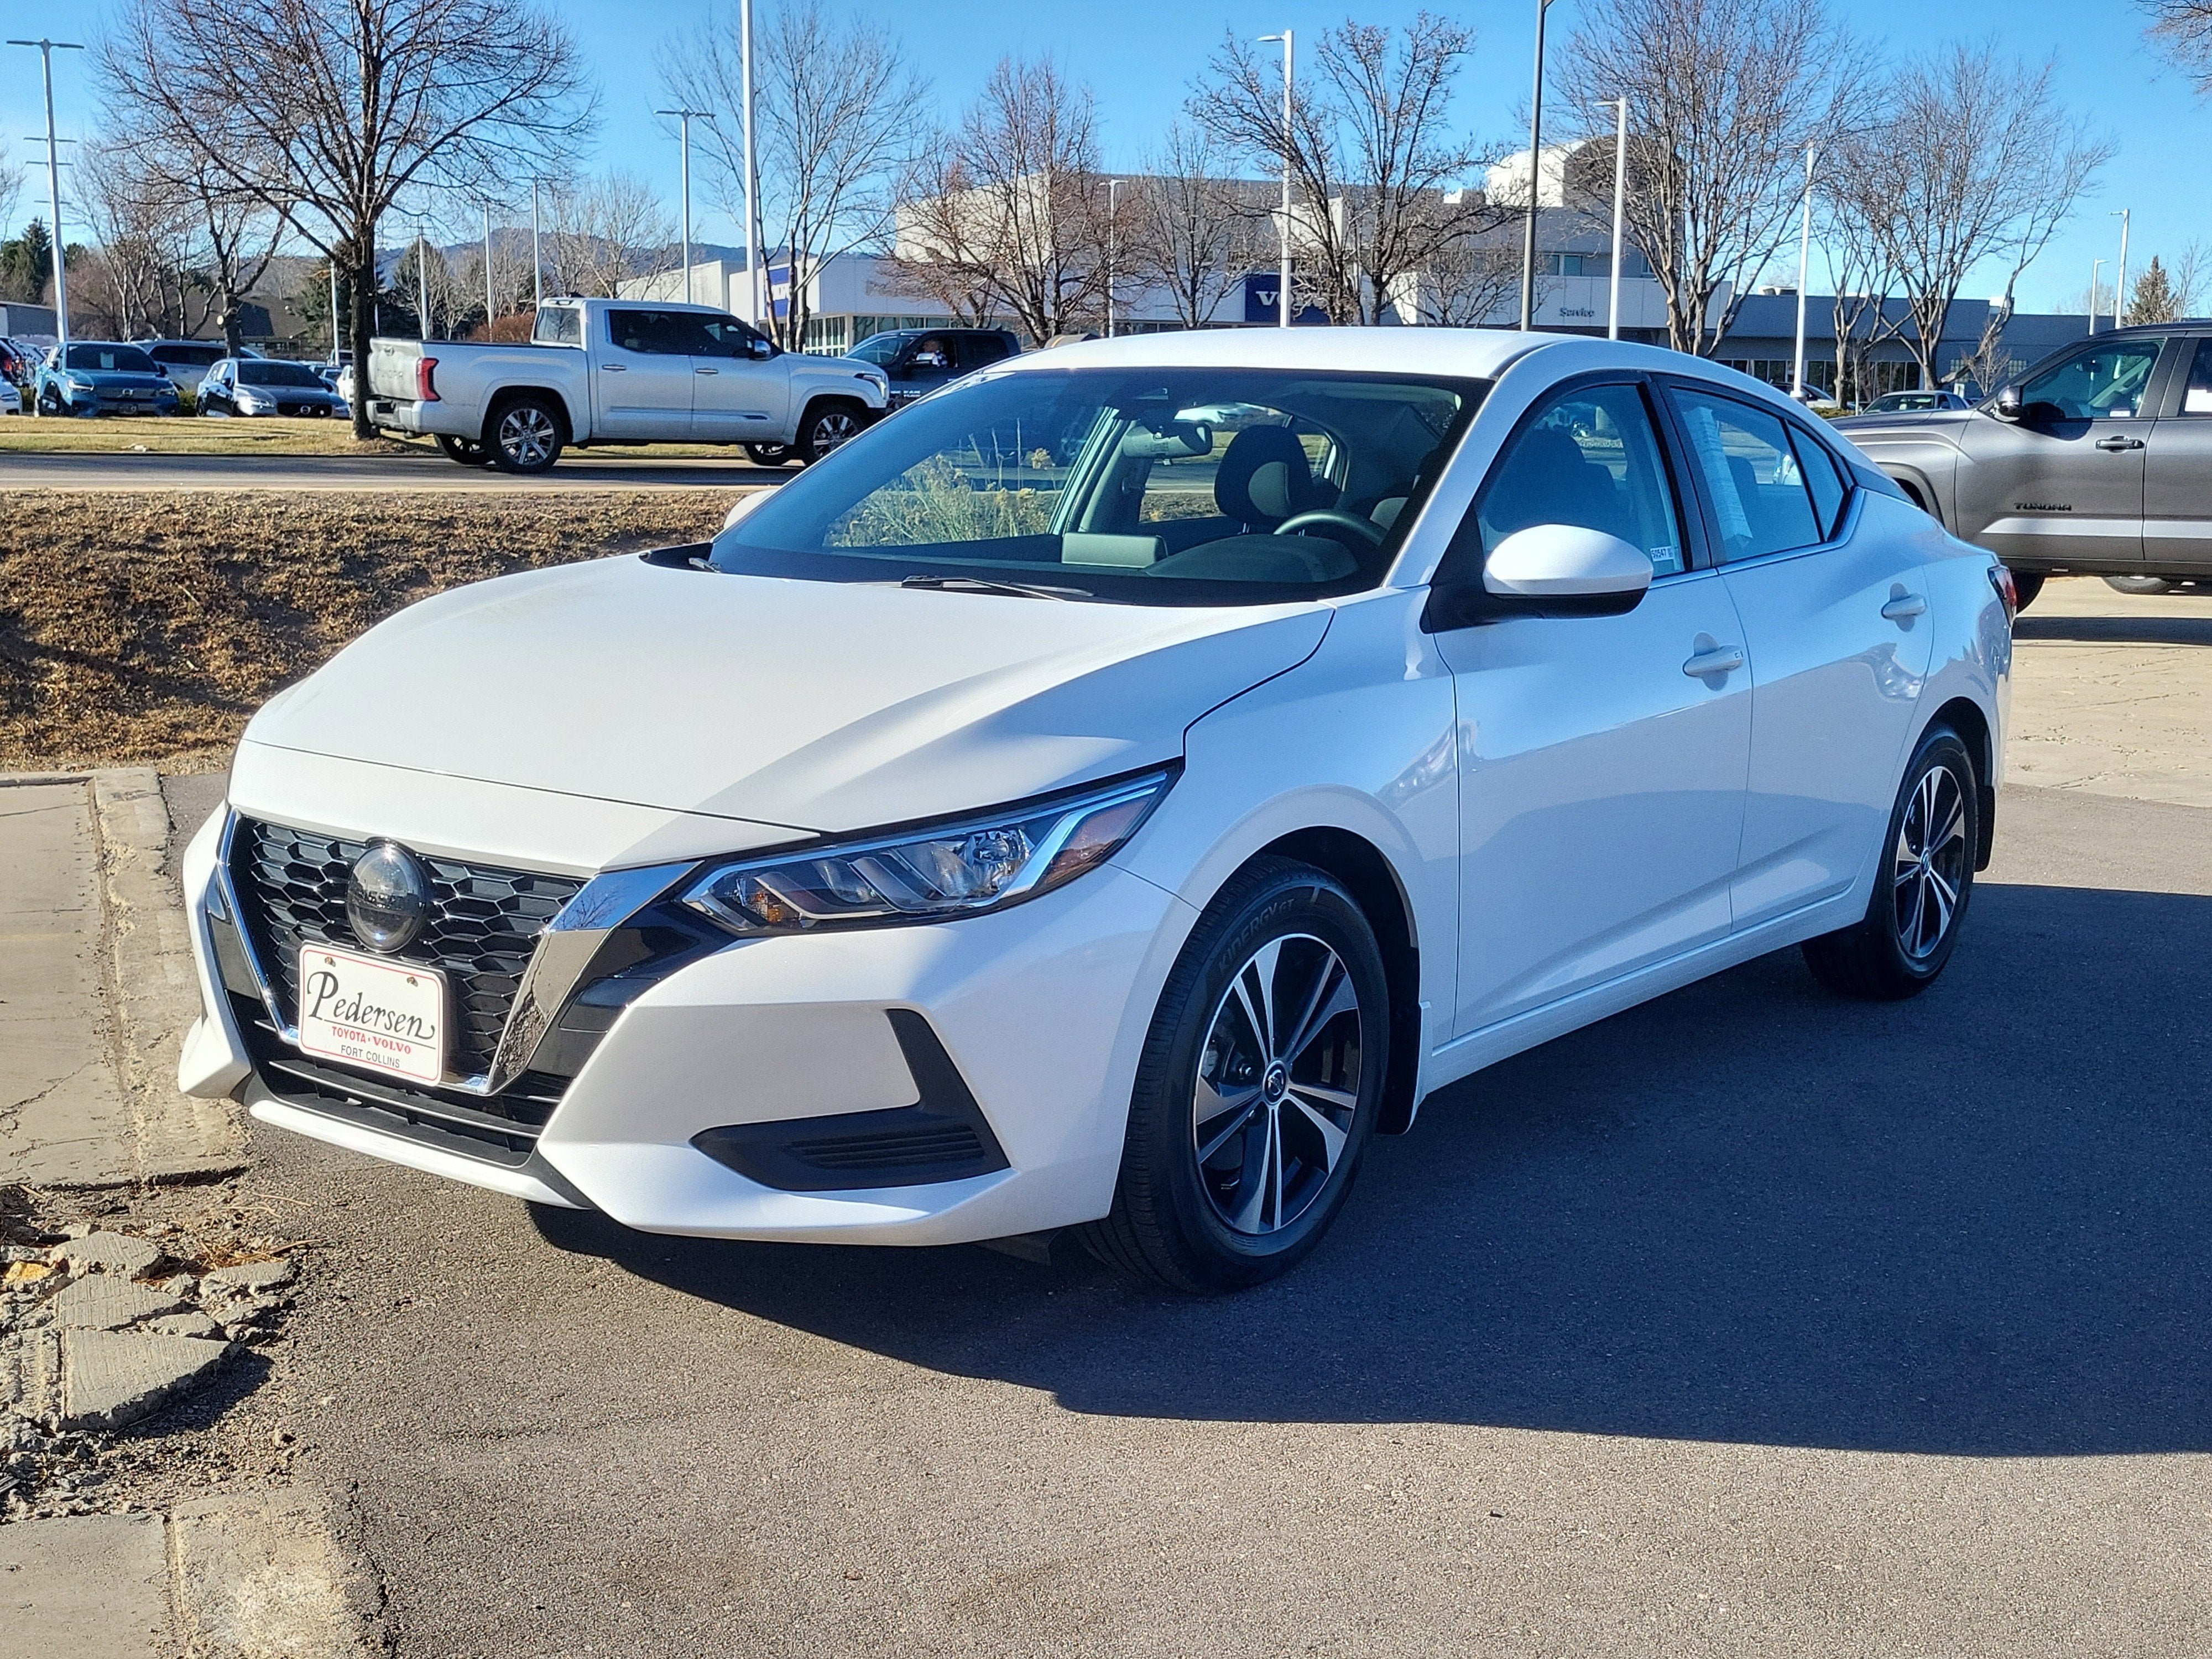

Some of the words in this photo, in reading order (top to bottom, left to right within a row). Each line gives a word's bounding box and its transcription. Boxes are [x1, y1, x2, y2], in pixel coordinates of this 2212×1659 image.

[1219, 902, 1277, 974] KINERGY
[307, 971, 436, 1040] Pedersen
[332, 1026, 367, 1044] TOYOTA
[372, 1035, 411, 1055] VOLVO
[341, 1045, 363, 1058] FORT
[366, 1051, 400, 1068] COLLINS
